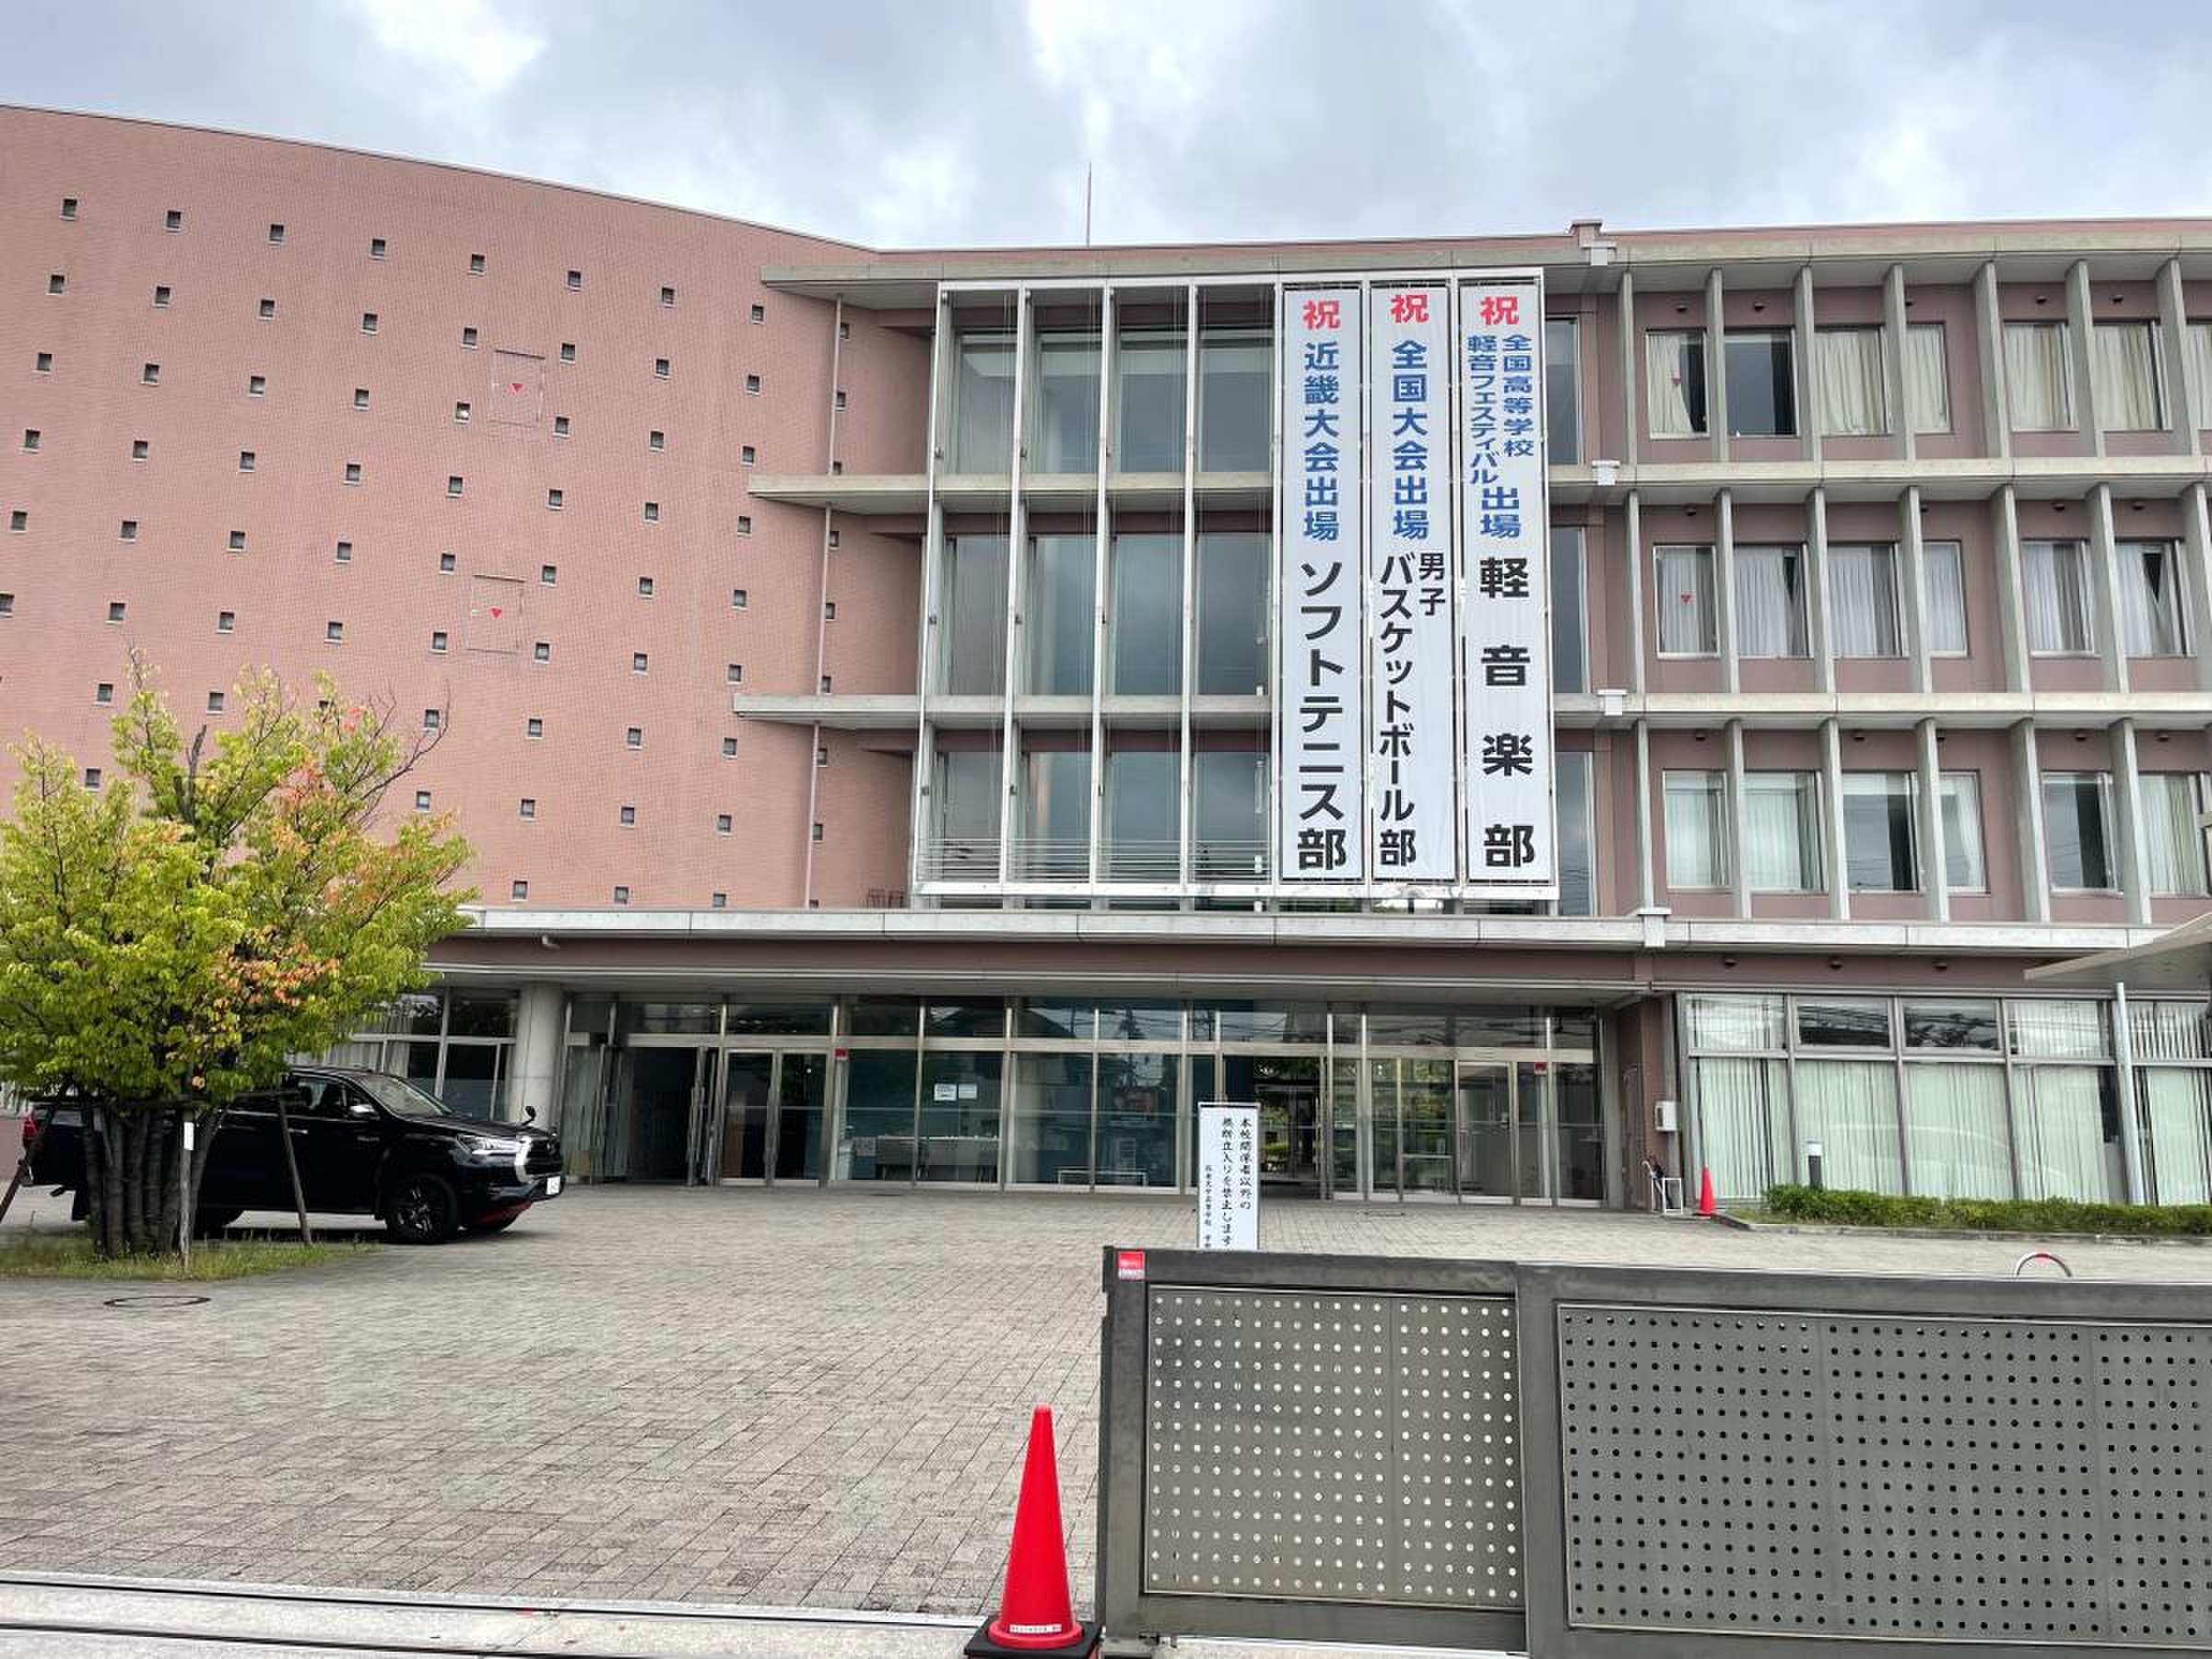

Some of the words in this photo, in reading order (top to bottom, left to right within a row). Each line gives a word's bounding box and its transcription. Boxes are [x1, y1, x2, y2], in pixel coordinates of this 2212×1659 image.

[1302, 300, 1341, 329] 祝
[1390, 294, 1430, 324] 祝
[1479, 296, 1520, 325] 祝
[1303, 341, 1340, 541] 近畿大会出場
[1392, 340, 1430, 540] 全国大会出場
[1467, 335, 1500, 485] 軽音フェスティバル
[1501, 334, 1535, 457] 全国高等学校
[1479, 487, 1521, 538] 出場
[1418, 552, 1446, 616] 男子
[1298, 561, 1347, 871] ソフトテニス部
[1380, 551, 1417, 867] バスケットボール部
[1480, 557, 1535, 868] 軽音楽部
